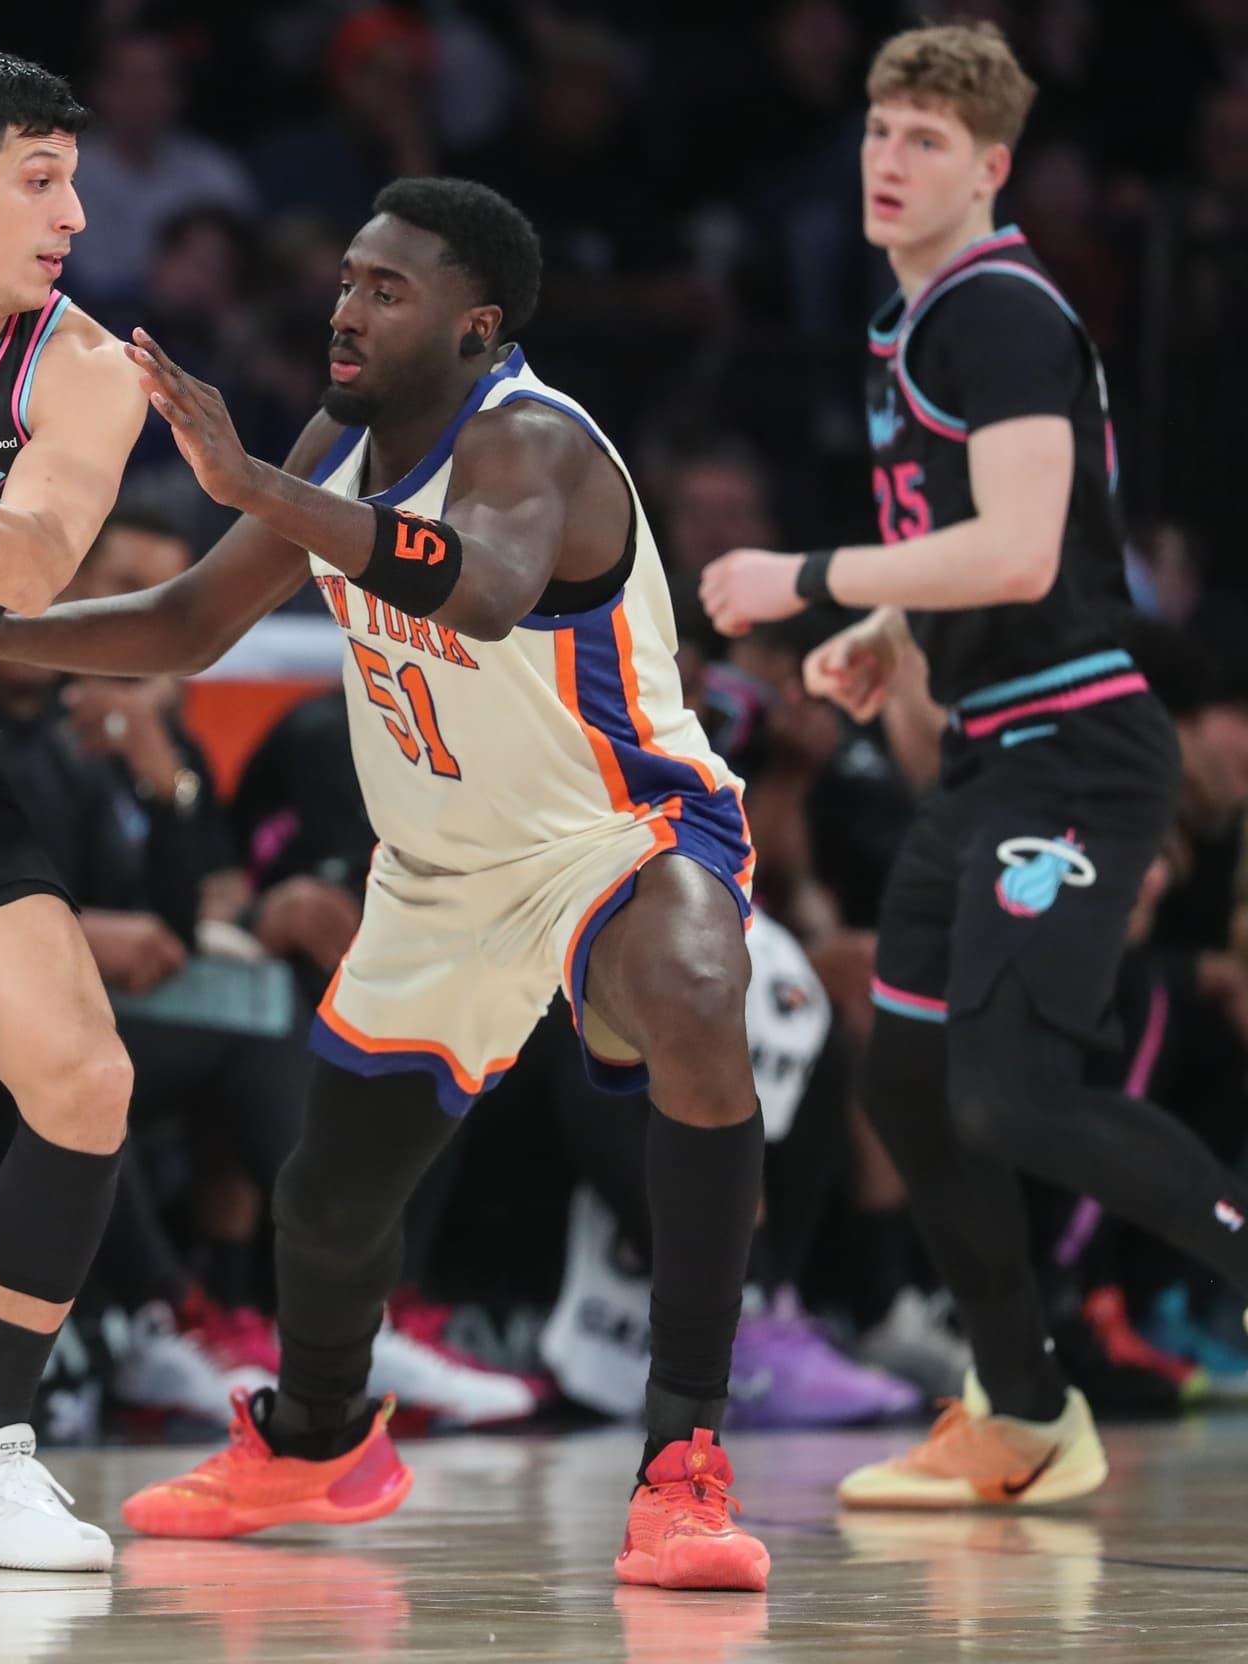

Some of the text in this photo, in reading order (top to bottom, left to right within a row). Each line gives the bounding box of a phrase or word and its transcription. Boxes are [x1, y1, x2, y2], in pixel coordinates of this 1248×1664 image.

[872, 461, 931, 546] 25
[363, 591, 480, 670] YORK
[348, 636, 462, 782] 51
